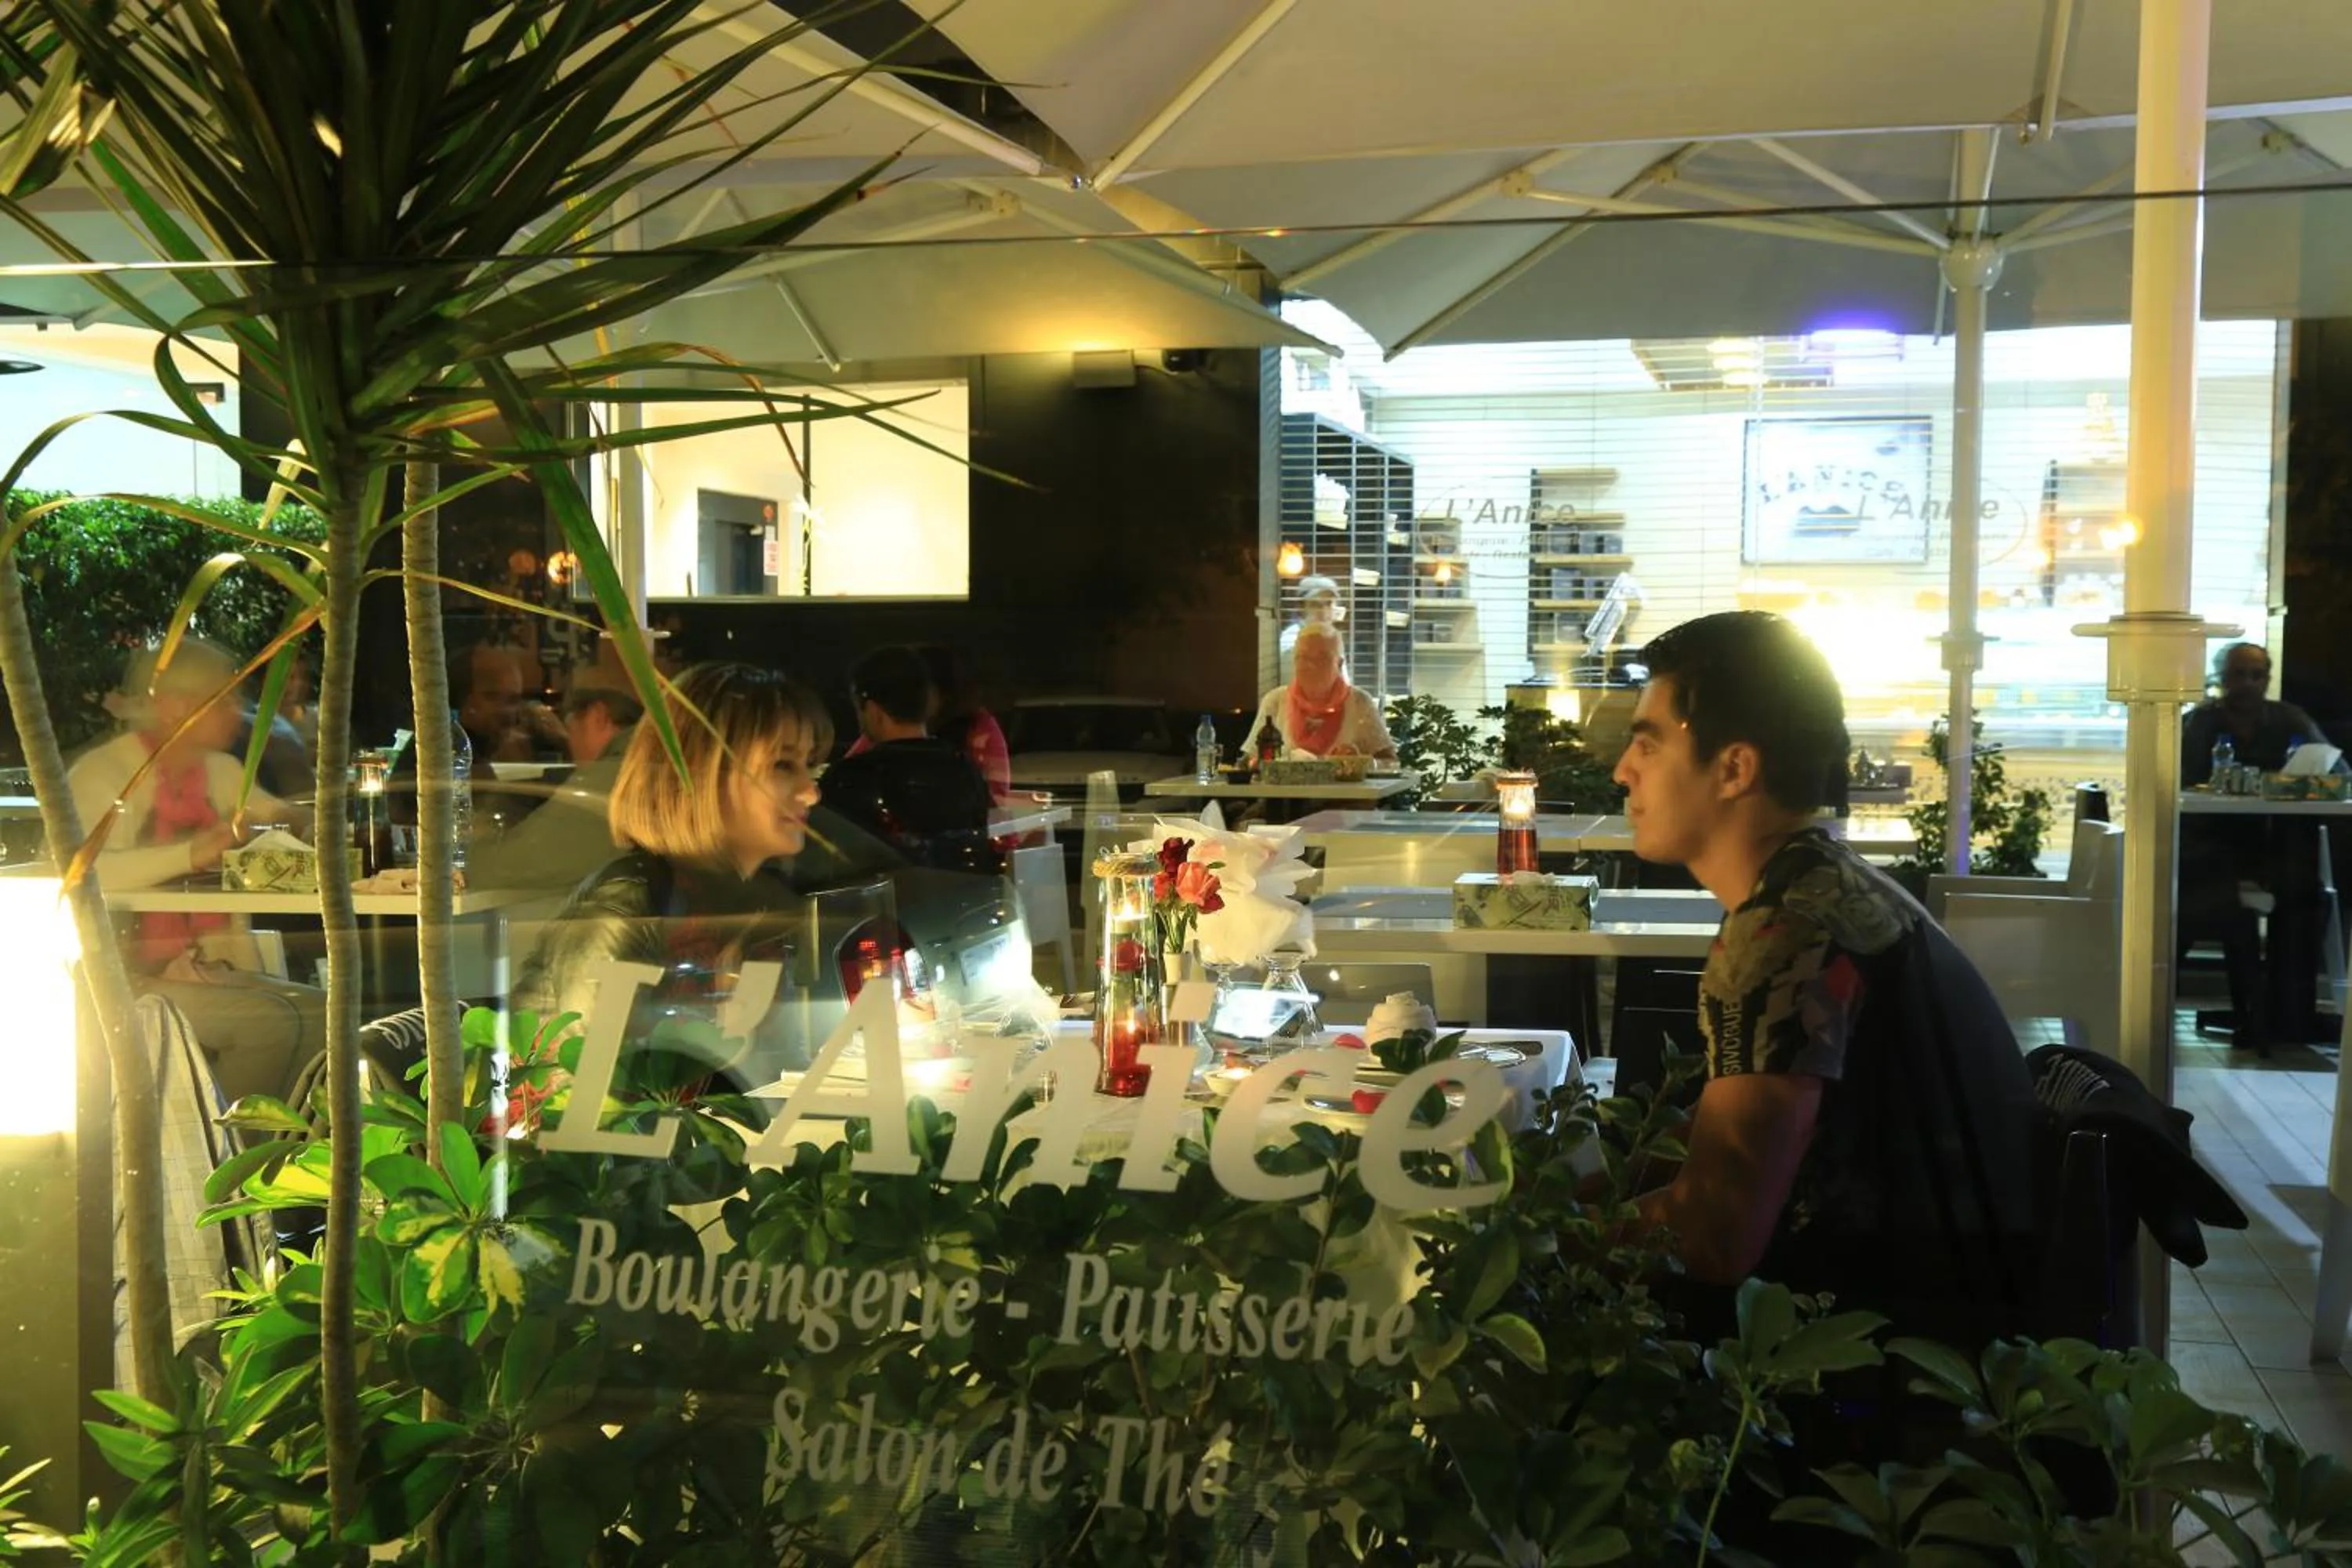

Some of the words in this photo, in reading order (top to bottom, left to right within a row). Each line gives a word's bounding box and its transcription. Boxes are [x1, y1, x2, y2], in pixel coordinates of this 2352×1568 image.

[536, 960, 1508, 1210] L'Anice
[566, 1217, 981, 1354] Boulangerie
[767, 1386, 959, 1495] Salon
[984, 1408, 1068, 1503] de
[1097, 1415, 1236, 1518] Thé
